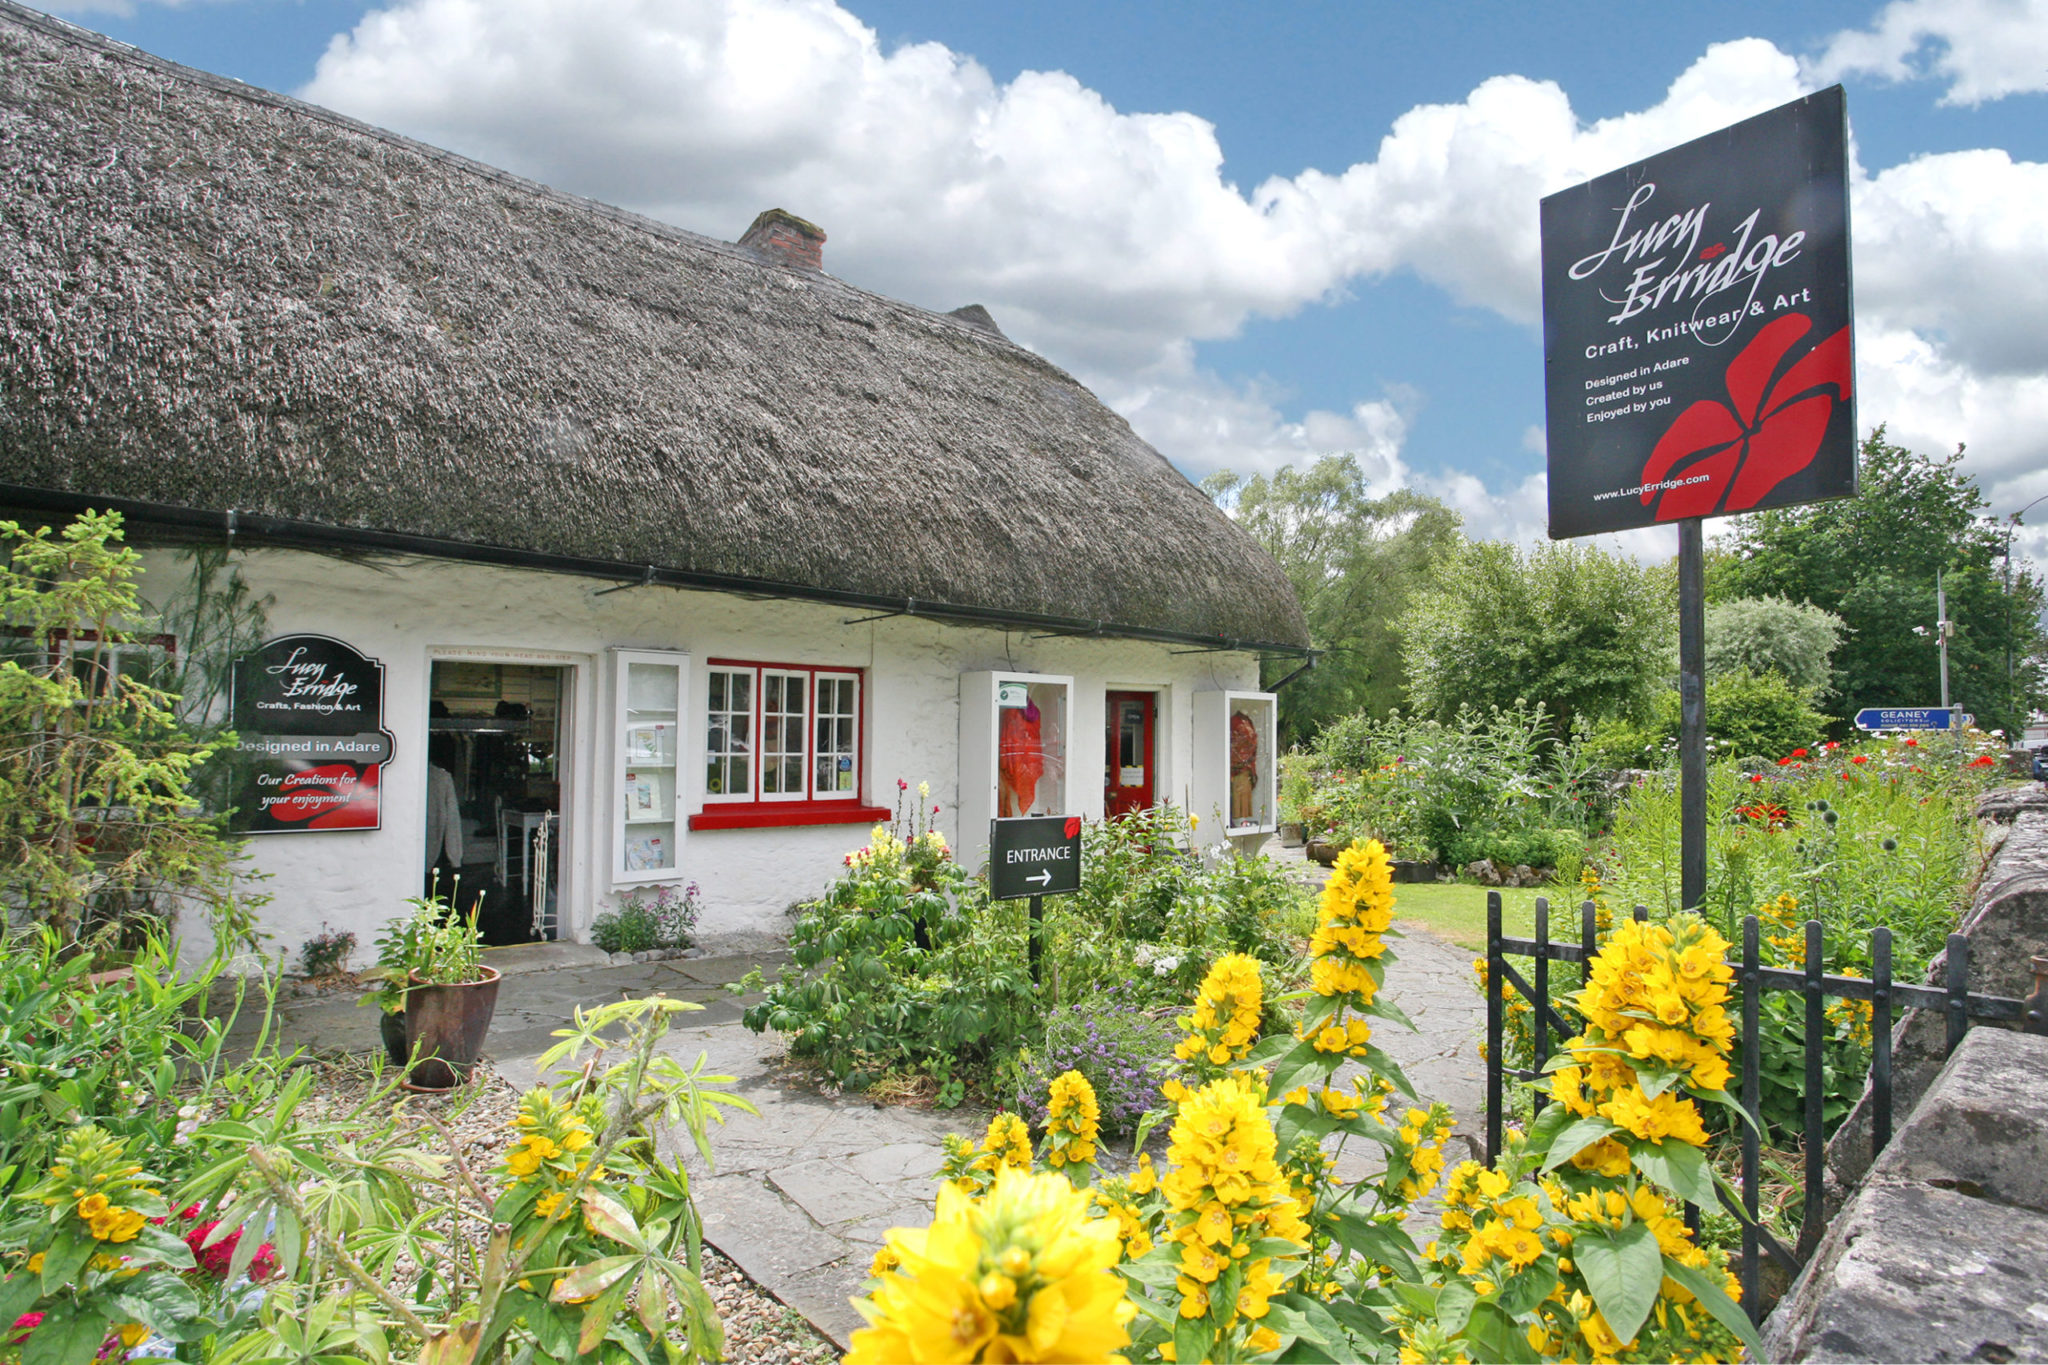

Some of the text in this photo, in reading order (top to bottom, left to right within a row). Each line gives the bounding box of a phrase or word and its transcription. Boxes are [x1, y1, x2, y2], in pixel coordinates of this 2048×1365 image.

[1568, 183, 1711, 303] Lucy
[1608, 208, 1806, 346] Erridge
[1585, 288, 1811, 359] Craft, Knitwear & Art
[1585, 356, 1690, 390] Designed in Adare
[1585, 380, 1663, 406] Created by us
[1586, 396, 1671, 423] Enjoyed by you
[1593, 474, 1710, 502] www.LucyErridge.com
[265, 646, 328, 689] Lucy
[256, 701, 292, 711] Crafts,
[293, 702, 333, 712] Fashion
[345, 703, 361, 712] Art
[282, 673, 358, 715] Erridge
[1880, 711, 1930, 719] GEANEY
[234, 741, 380, 754] Designed in Adare
[257, 772, 357, 787] Our Creations for
[258, 792, 351, 811] your enjoyment
[1006, 846, 1071, 864] ENTRANCE
